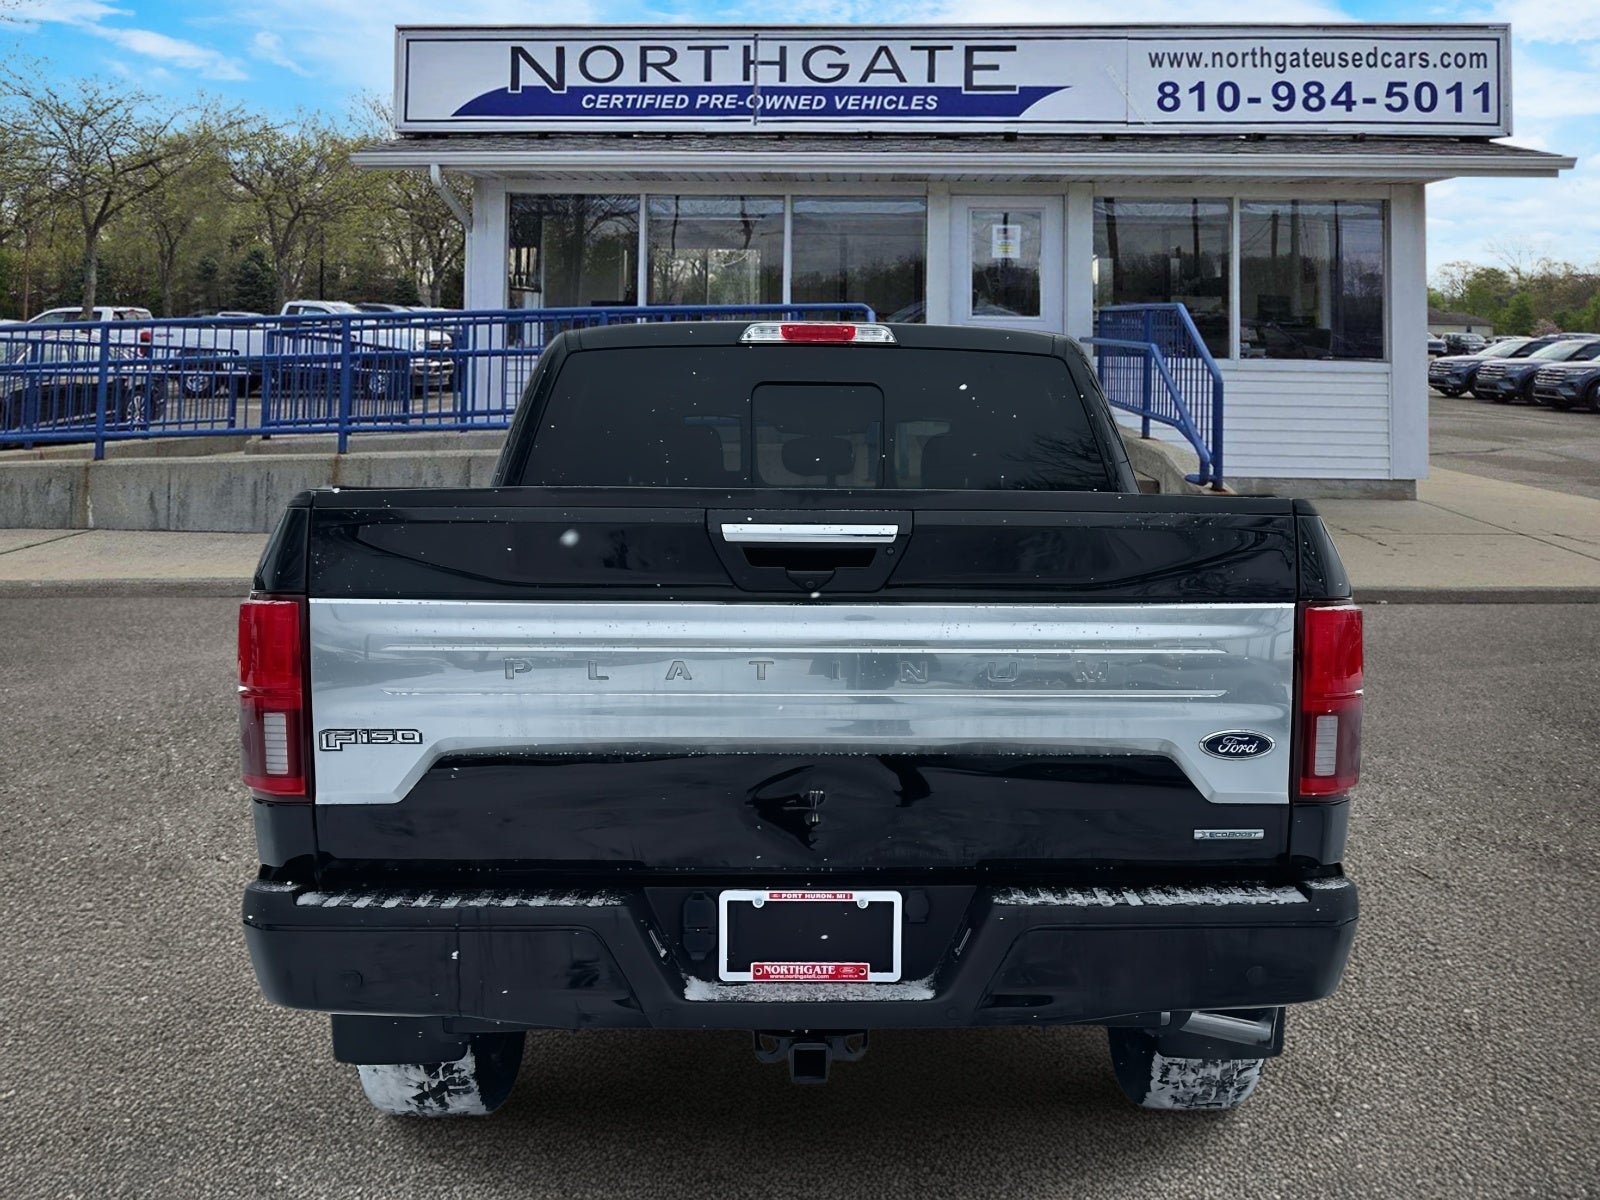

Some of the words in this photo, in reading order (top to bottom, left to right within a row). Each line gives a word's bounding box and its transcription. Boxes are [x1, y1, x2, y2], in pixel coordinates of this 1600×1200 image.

[509, 44, 1017, 93] NORTHGATE
[1148, 46, 1489, 73] www.northgateusedcars.com
[581, 93, 689, 110] CERTIFIED
[695, 93, 827, 111] PRE-OWNED
[833, 94, 939, 111] VEHICLES
[1156, 80, 1492, 114] 810-984-5011
[504, 658, 1110, 684] PLATINUM
[1217, 735, 1259, 753] Ford
[763, 965, 836, 974] NORTHGATE
